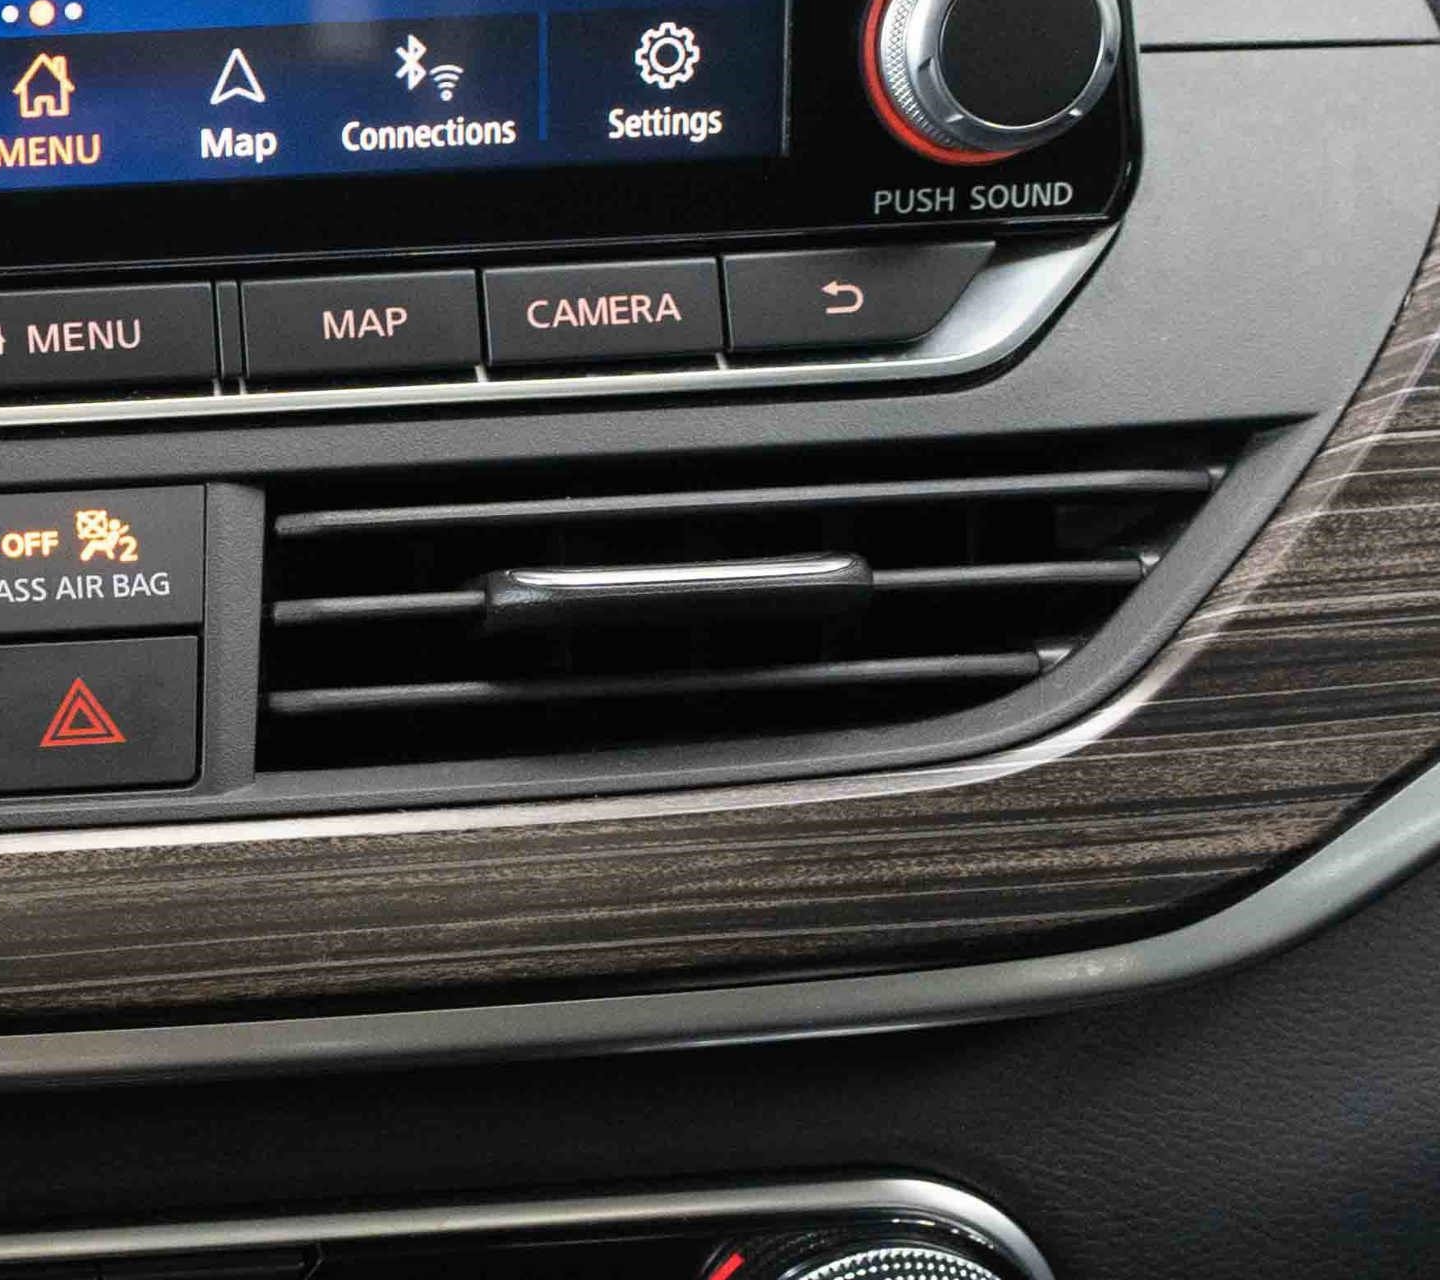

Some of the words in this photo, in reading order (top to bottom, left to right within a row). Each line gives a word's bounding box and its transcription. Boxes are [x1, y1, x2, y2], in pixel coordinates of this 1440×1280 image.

[341, 115, 517, 152] Connections
[608, 106, 722, 143] Settings
[200, 127, 278, 164] Map
[874, 186, 955, 215] PUSH
[970, 181, 1073, 210] SOUND
[322, 307, 408, 340] MAP
[526, 292, 682, 329] CAMERA
[27, 319, 141, 354] MENU
[0, 530, 60, 559] OFF
[55, 574, 105, 600] AIR
[112, 572, 170, 598] BAG
